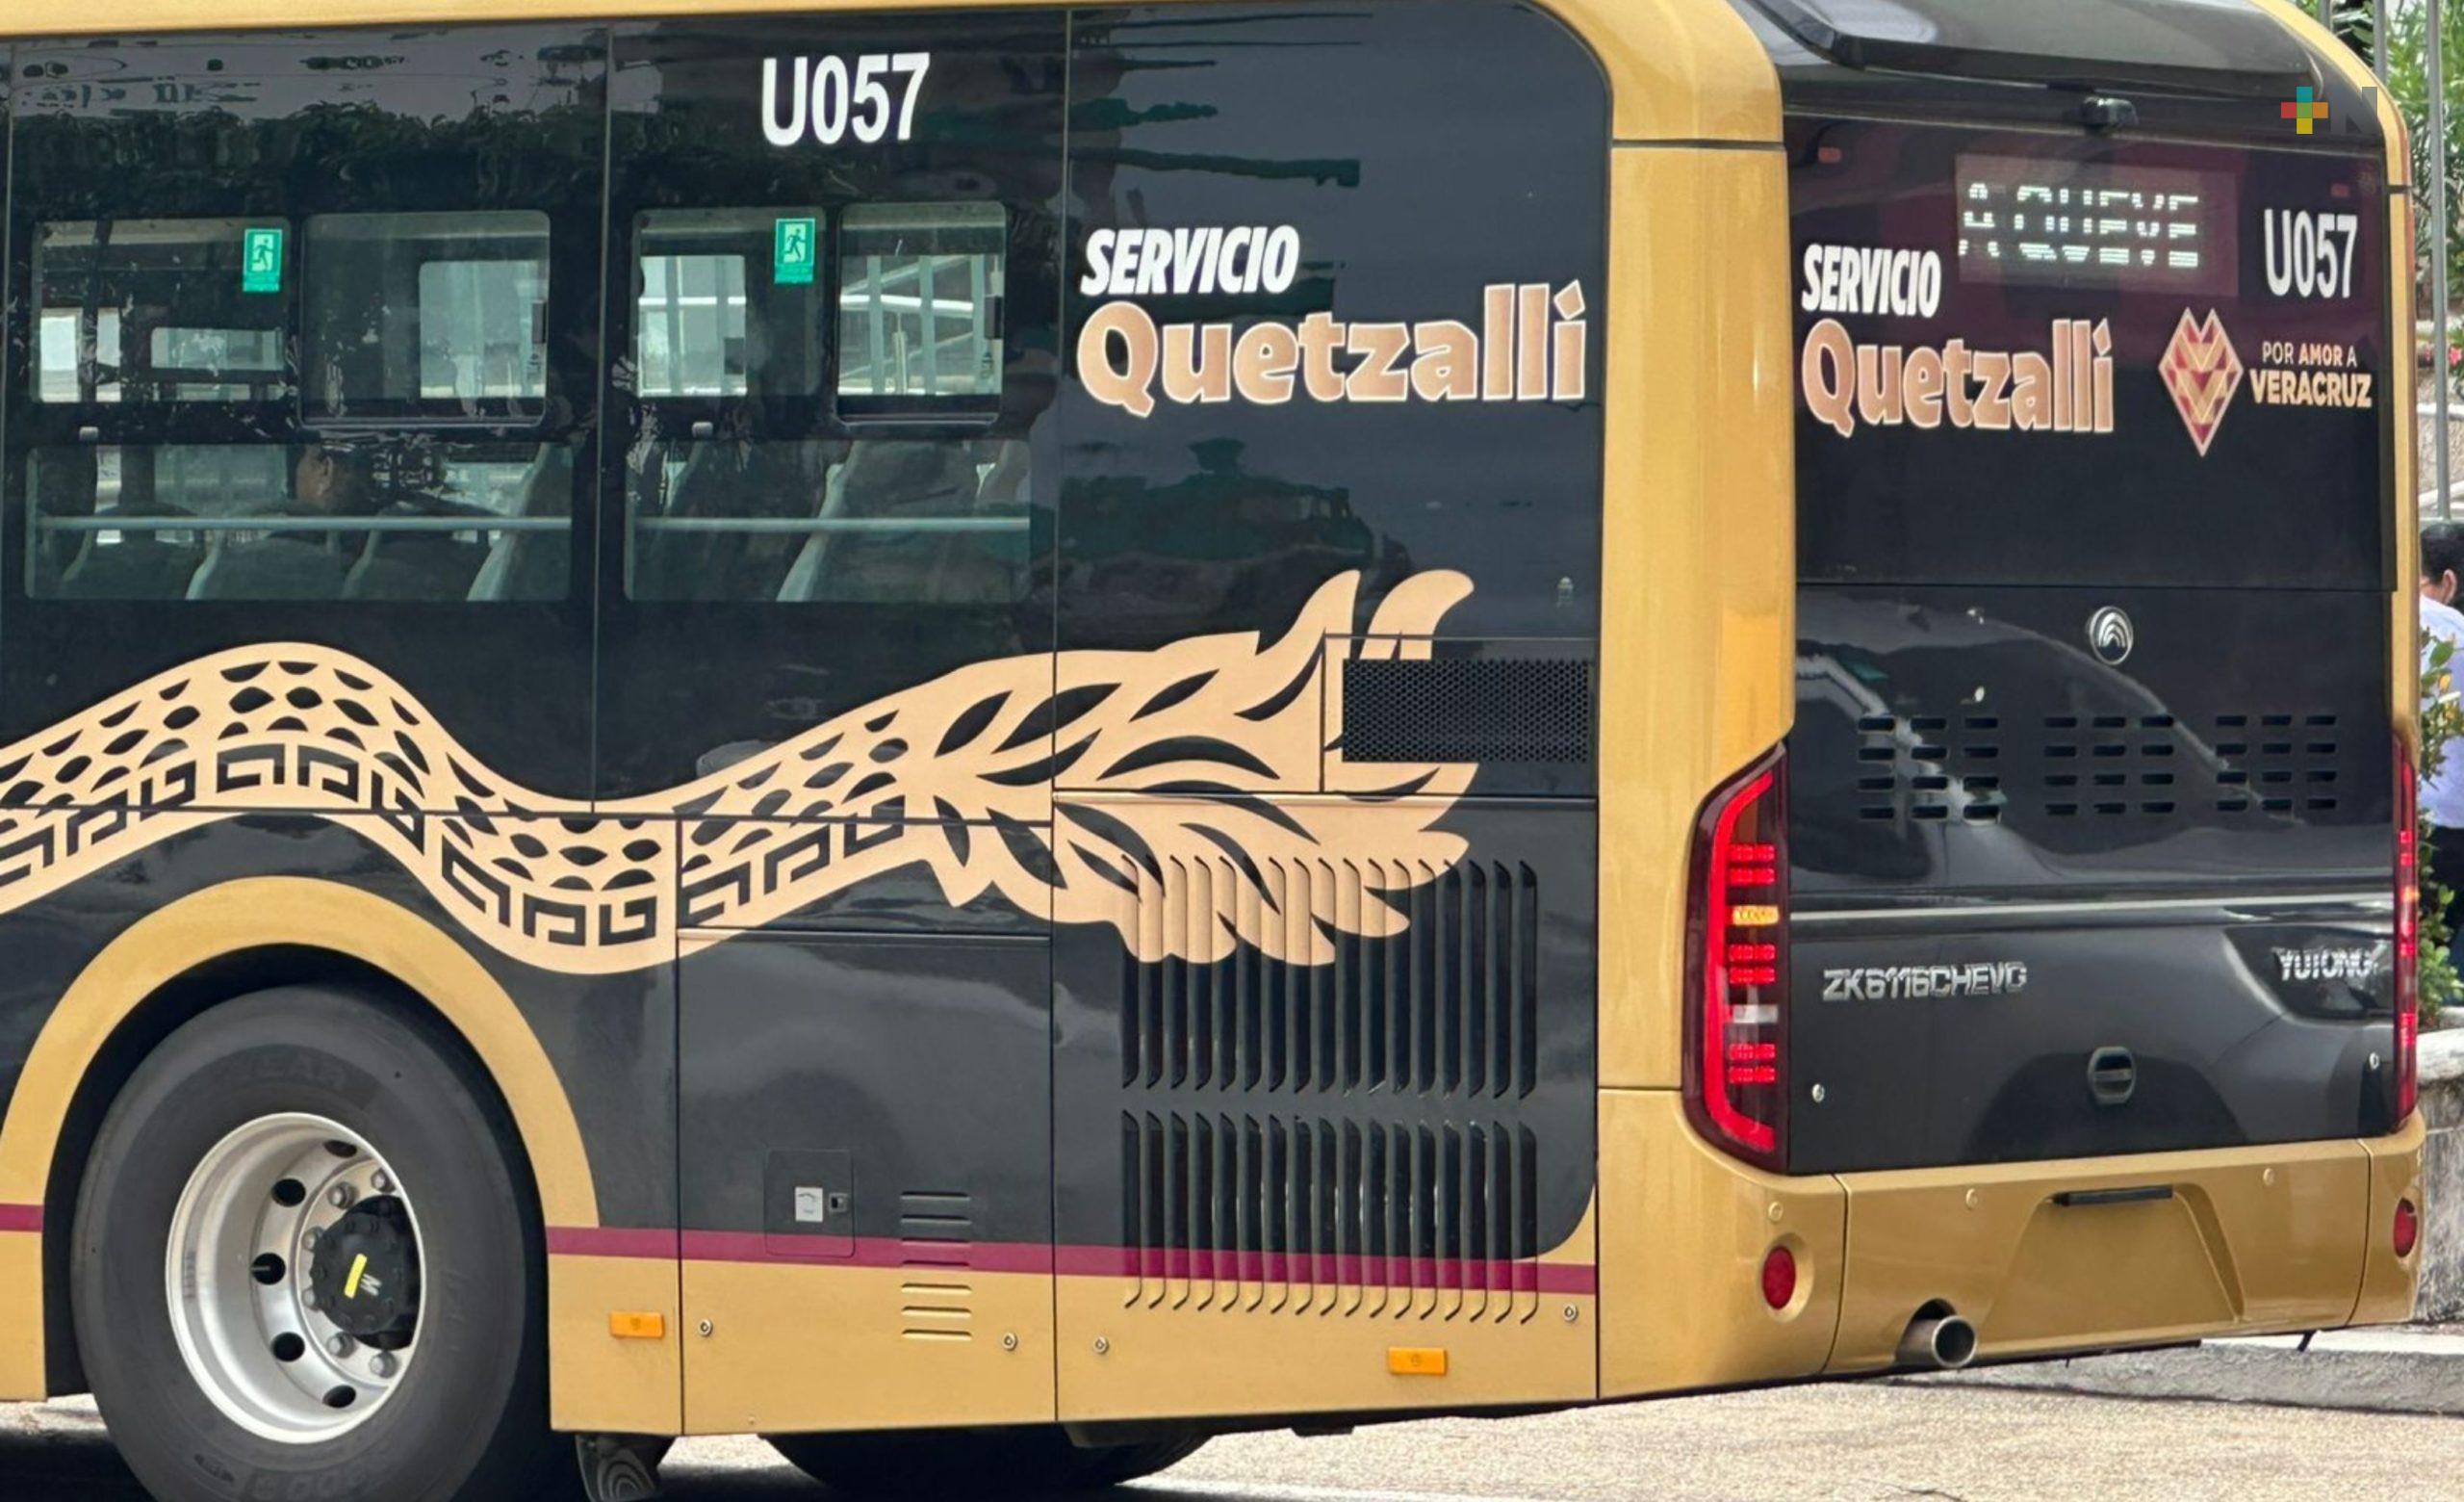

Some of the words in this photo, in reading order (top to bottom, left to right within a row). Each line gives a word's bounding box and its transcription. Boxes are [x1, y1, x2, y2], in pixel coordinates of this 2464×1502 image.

[761, 53, 930, 145] U057
[1080, 225, 1300, 296] SERVICIO
[1802, 244, 1942, 319] SERVICIO
[2264, 209, 2358, 298] U057
[2249, 368, 2372, 408] VERACRUZ
[2263, 341, 2294, 364] POR
[2298, 343, 2343, 367] AMOR
[2346, 345, 2357, 368] A
